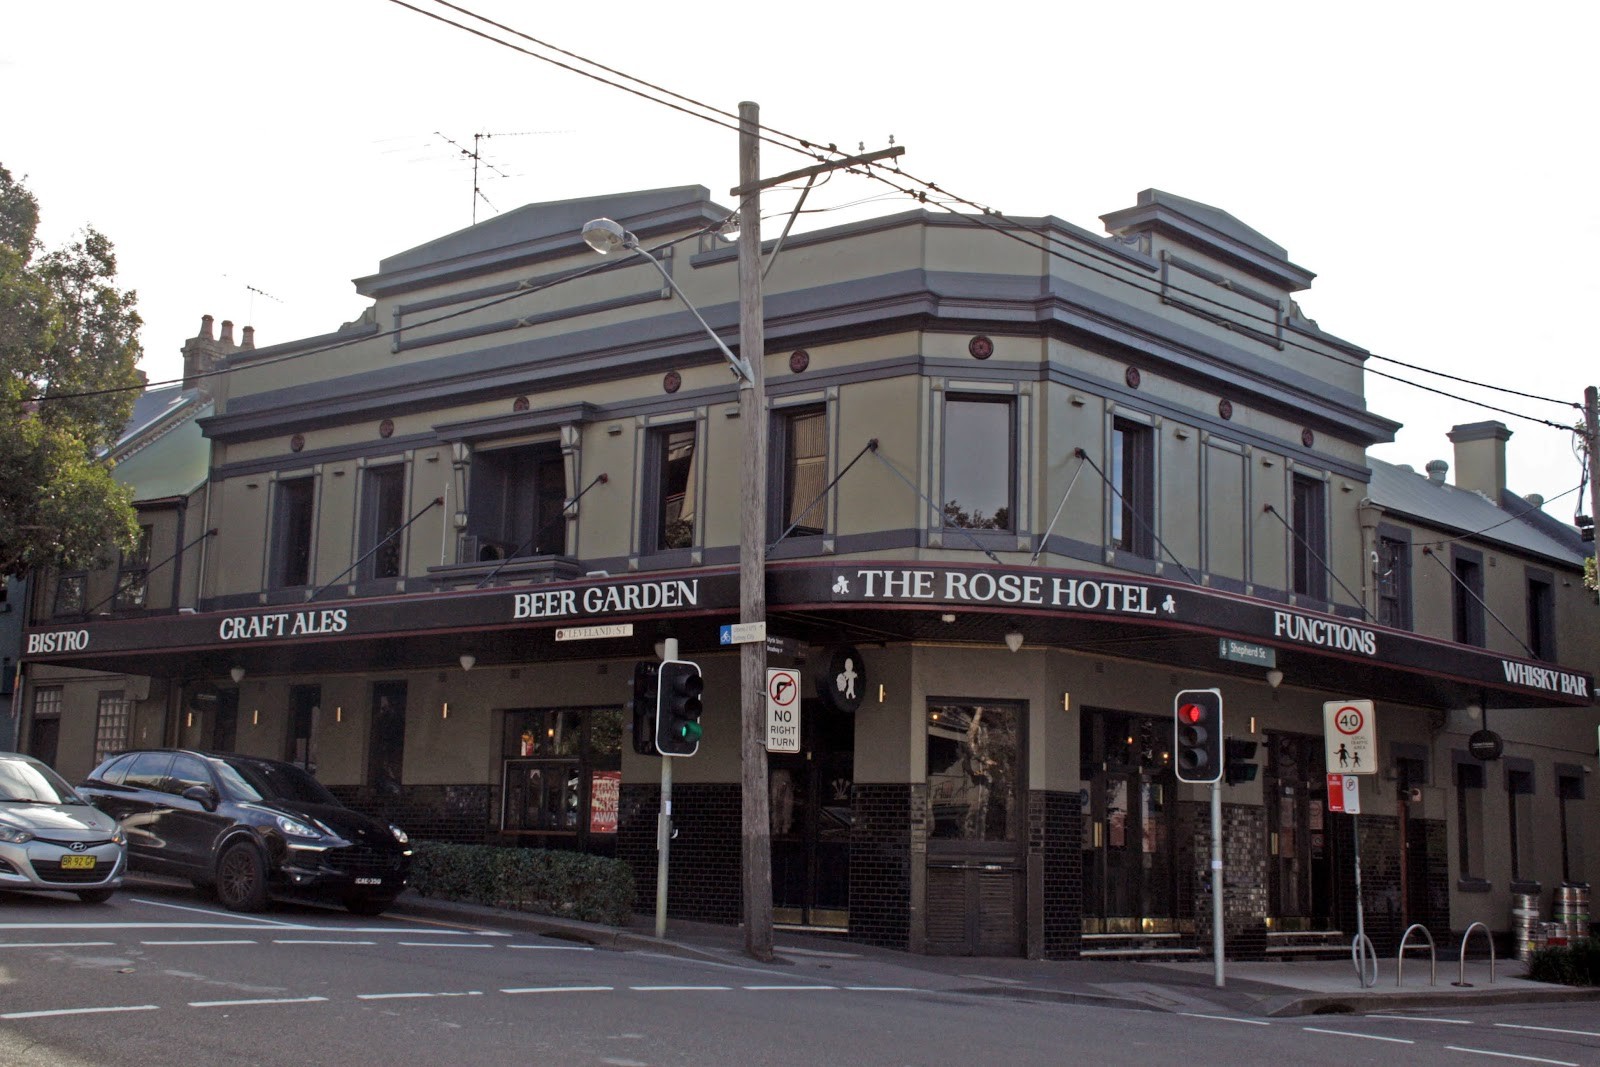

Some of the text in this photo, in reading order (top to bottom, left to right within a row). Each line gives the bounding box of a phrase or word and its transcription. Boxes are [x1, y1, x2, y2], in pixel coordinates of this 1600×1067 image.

[513, 579, 699, 619] BEER GARDEN
[857, 570, 1157, 615] THE ROSE HOTEL
[219, 609, 348, 640] CRAFT ALES
[1274, 611, 1376, 656] FUNCTIONS
[27, 629, 89, 654] BISTRO
[1230, 641, 1266, 659] Shepherd St
[1501, 660, 1588, 697] WHISKY BAR
[774, 710, 792, 723] NO
[1339, 714, 1359, 727] 40
[770, 725, 796, 735] RIGHT
[771, 737, 795, 747] TURN
[597, 779, 620, 789] TAKE
[596, 801, 619, 811] TAKE
